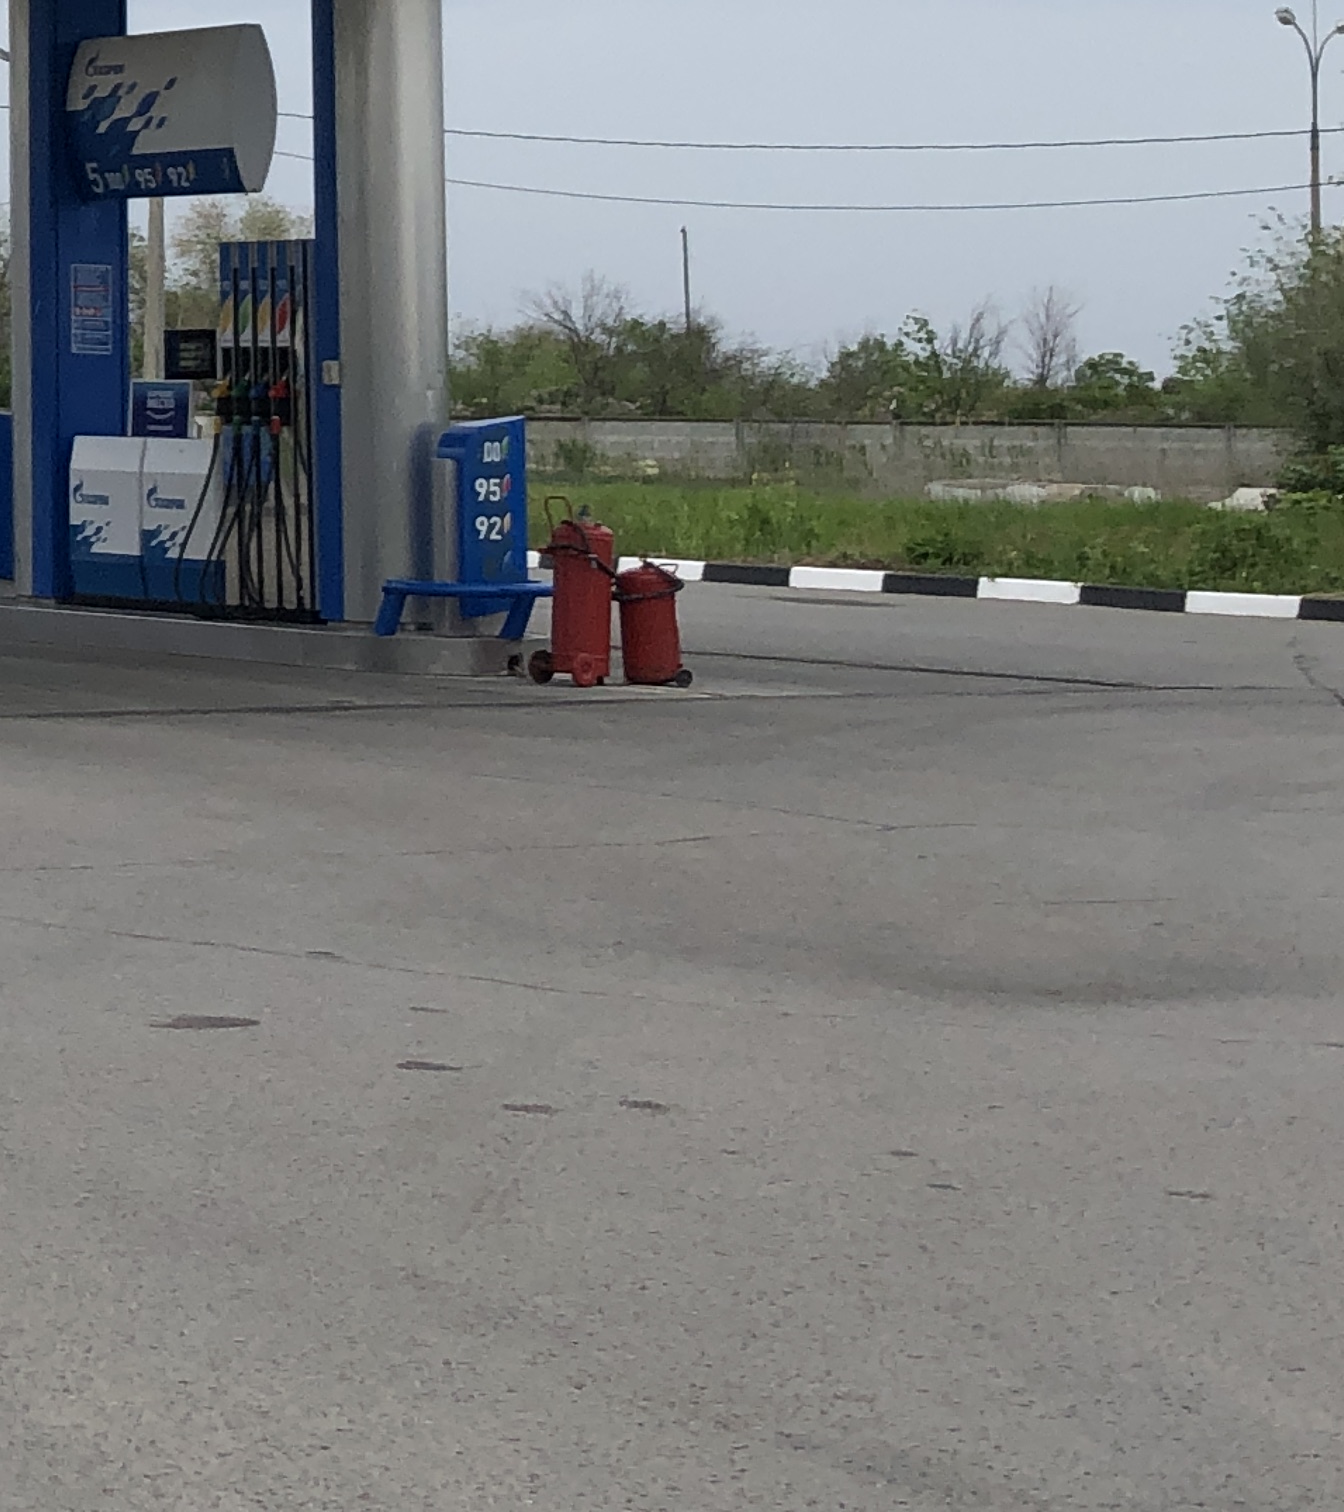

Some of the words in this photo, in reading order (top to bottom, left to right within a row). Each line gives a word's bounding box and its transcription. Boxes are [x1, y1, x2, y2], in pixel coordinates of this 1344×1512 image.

[85, 162, 104, 193] 5
[134, 168, 157, 189] 95
[166, 166, 190, 187] 92
[474, 477, 501, 501] 95
[474, 515, 503, 540] 92
